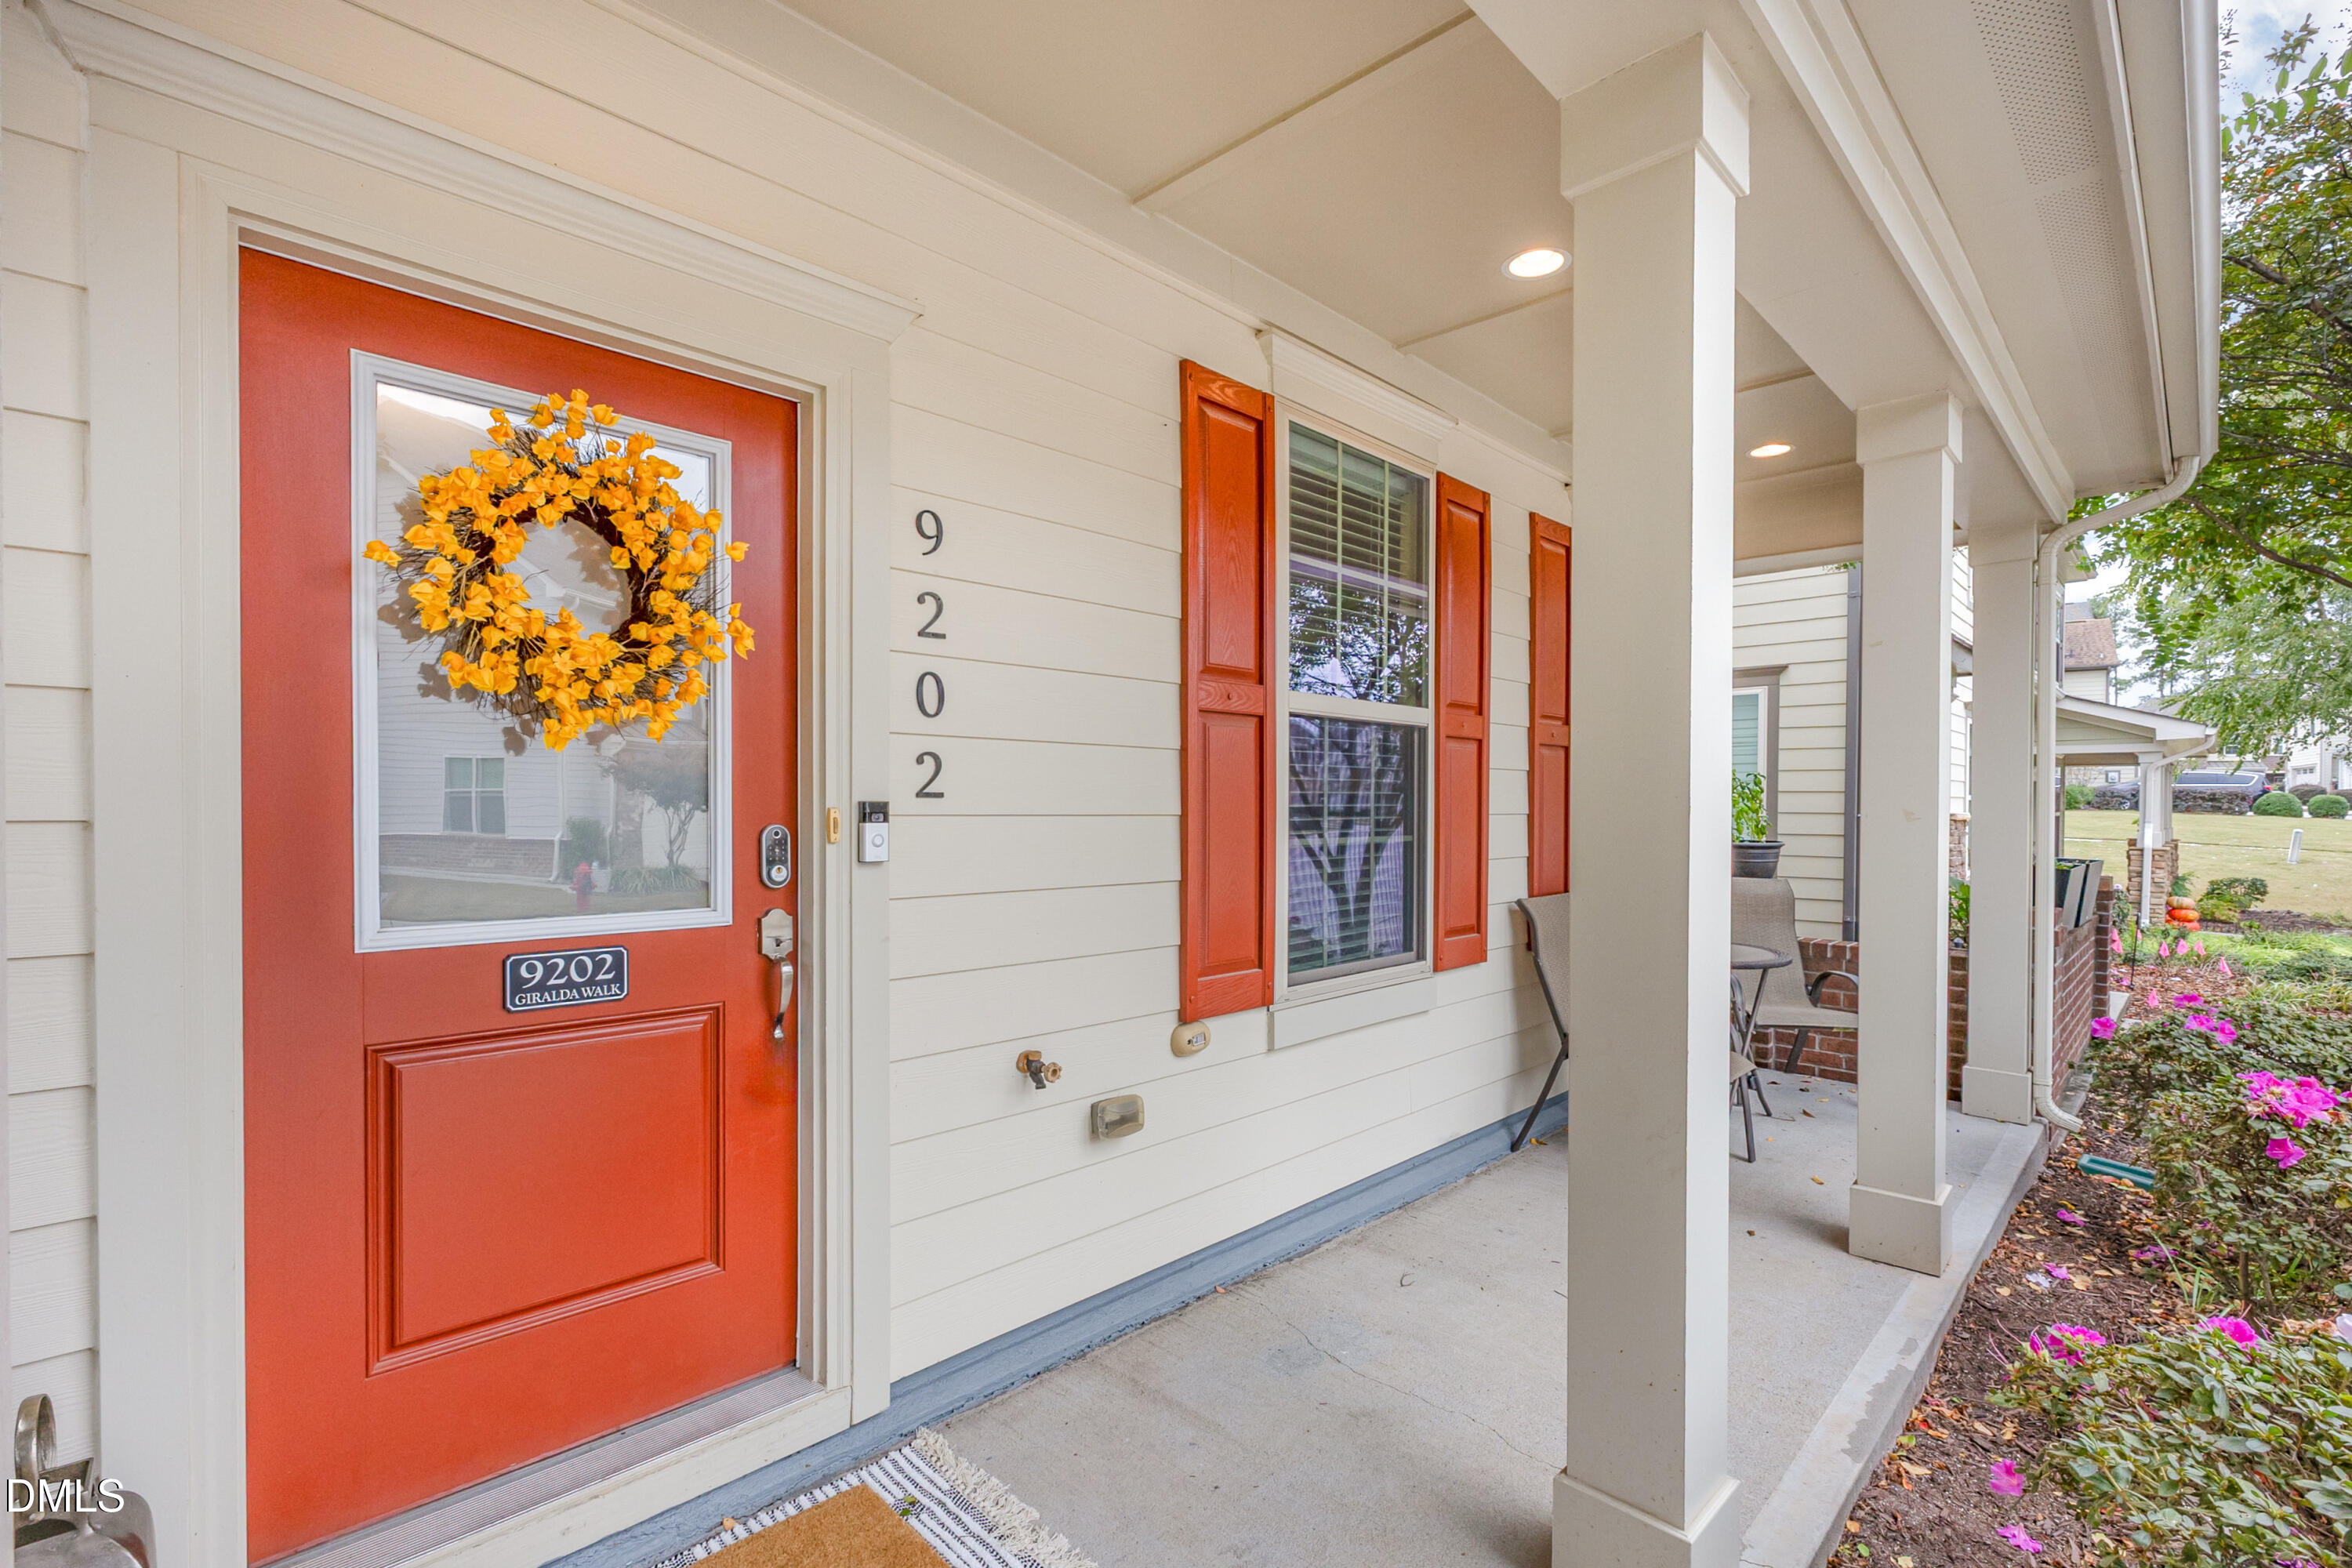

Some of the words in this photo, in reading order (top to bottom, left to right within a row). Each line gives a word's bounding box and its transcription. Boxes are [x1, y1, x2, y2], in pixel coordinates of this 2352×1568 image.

[520, 953, 615, 989] 9202
[515, 989, 579, 1005] GIRALDA
[580, 983, 622, 998] WALK
